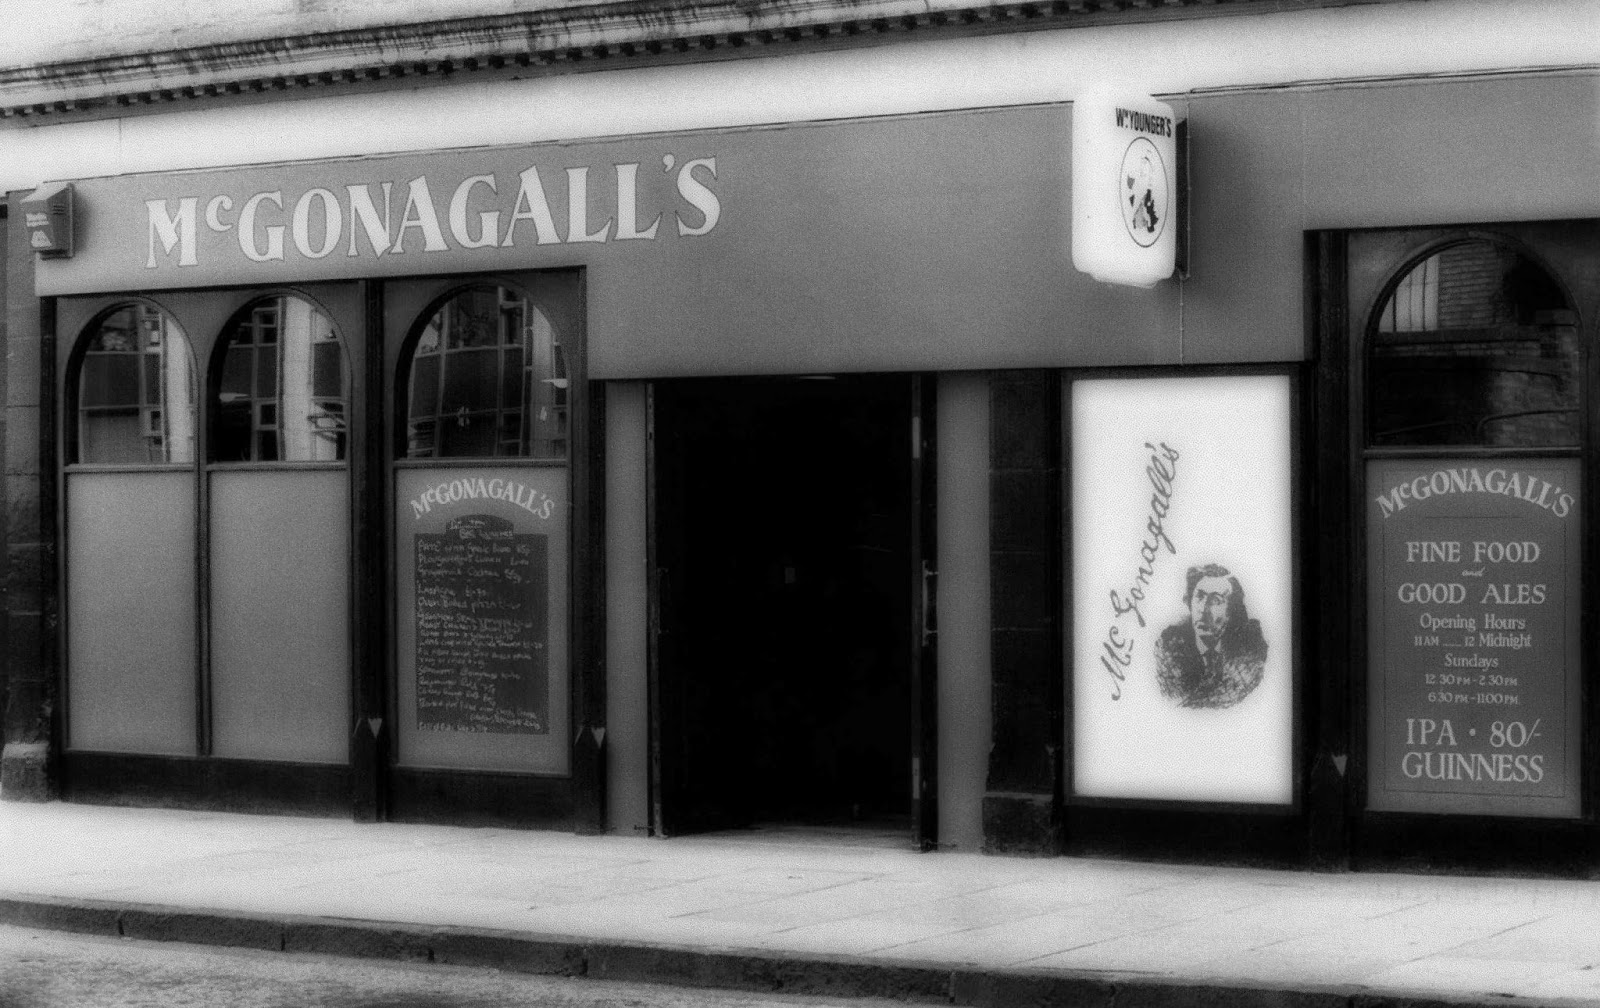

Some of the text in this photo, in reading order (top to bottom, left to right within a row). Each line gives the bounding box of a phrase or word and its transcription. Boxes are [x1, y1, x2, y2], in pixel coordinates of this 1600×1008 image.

[1129, 110, 1172, 138] YOUNGER'S
[1406, 542, 1541, 563] FINE FOOD
[1462, 566, 1486, 577] and
[1398, 583, 1546, 605] GOOD ALES
[1420, 612, 1526, 632] Opening Hours
[1464, 636, 1475, 647] 12
[1479, 633, 1532, 650] Midnight
[1444, 653, 1499, 672] Sundays
[1406, 718, 1457, 746] IPA
[1401, 751, 1544, 783] GUINNESS
